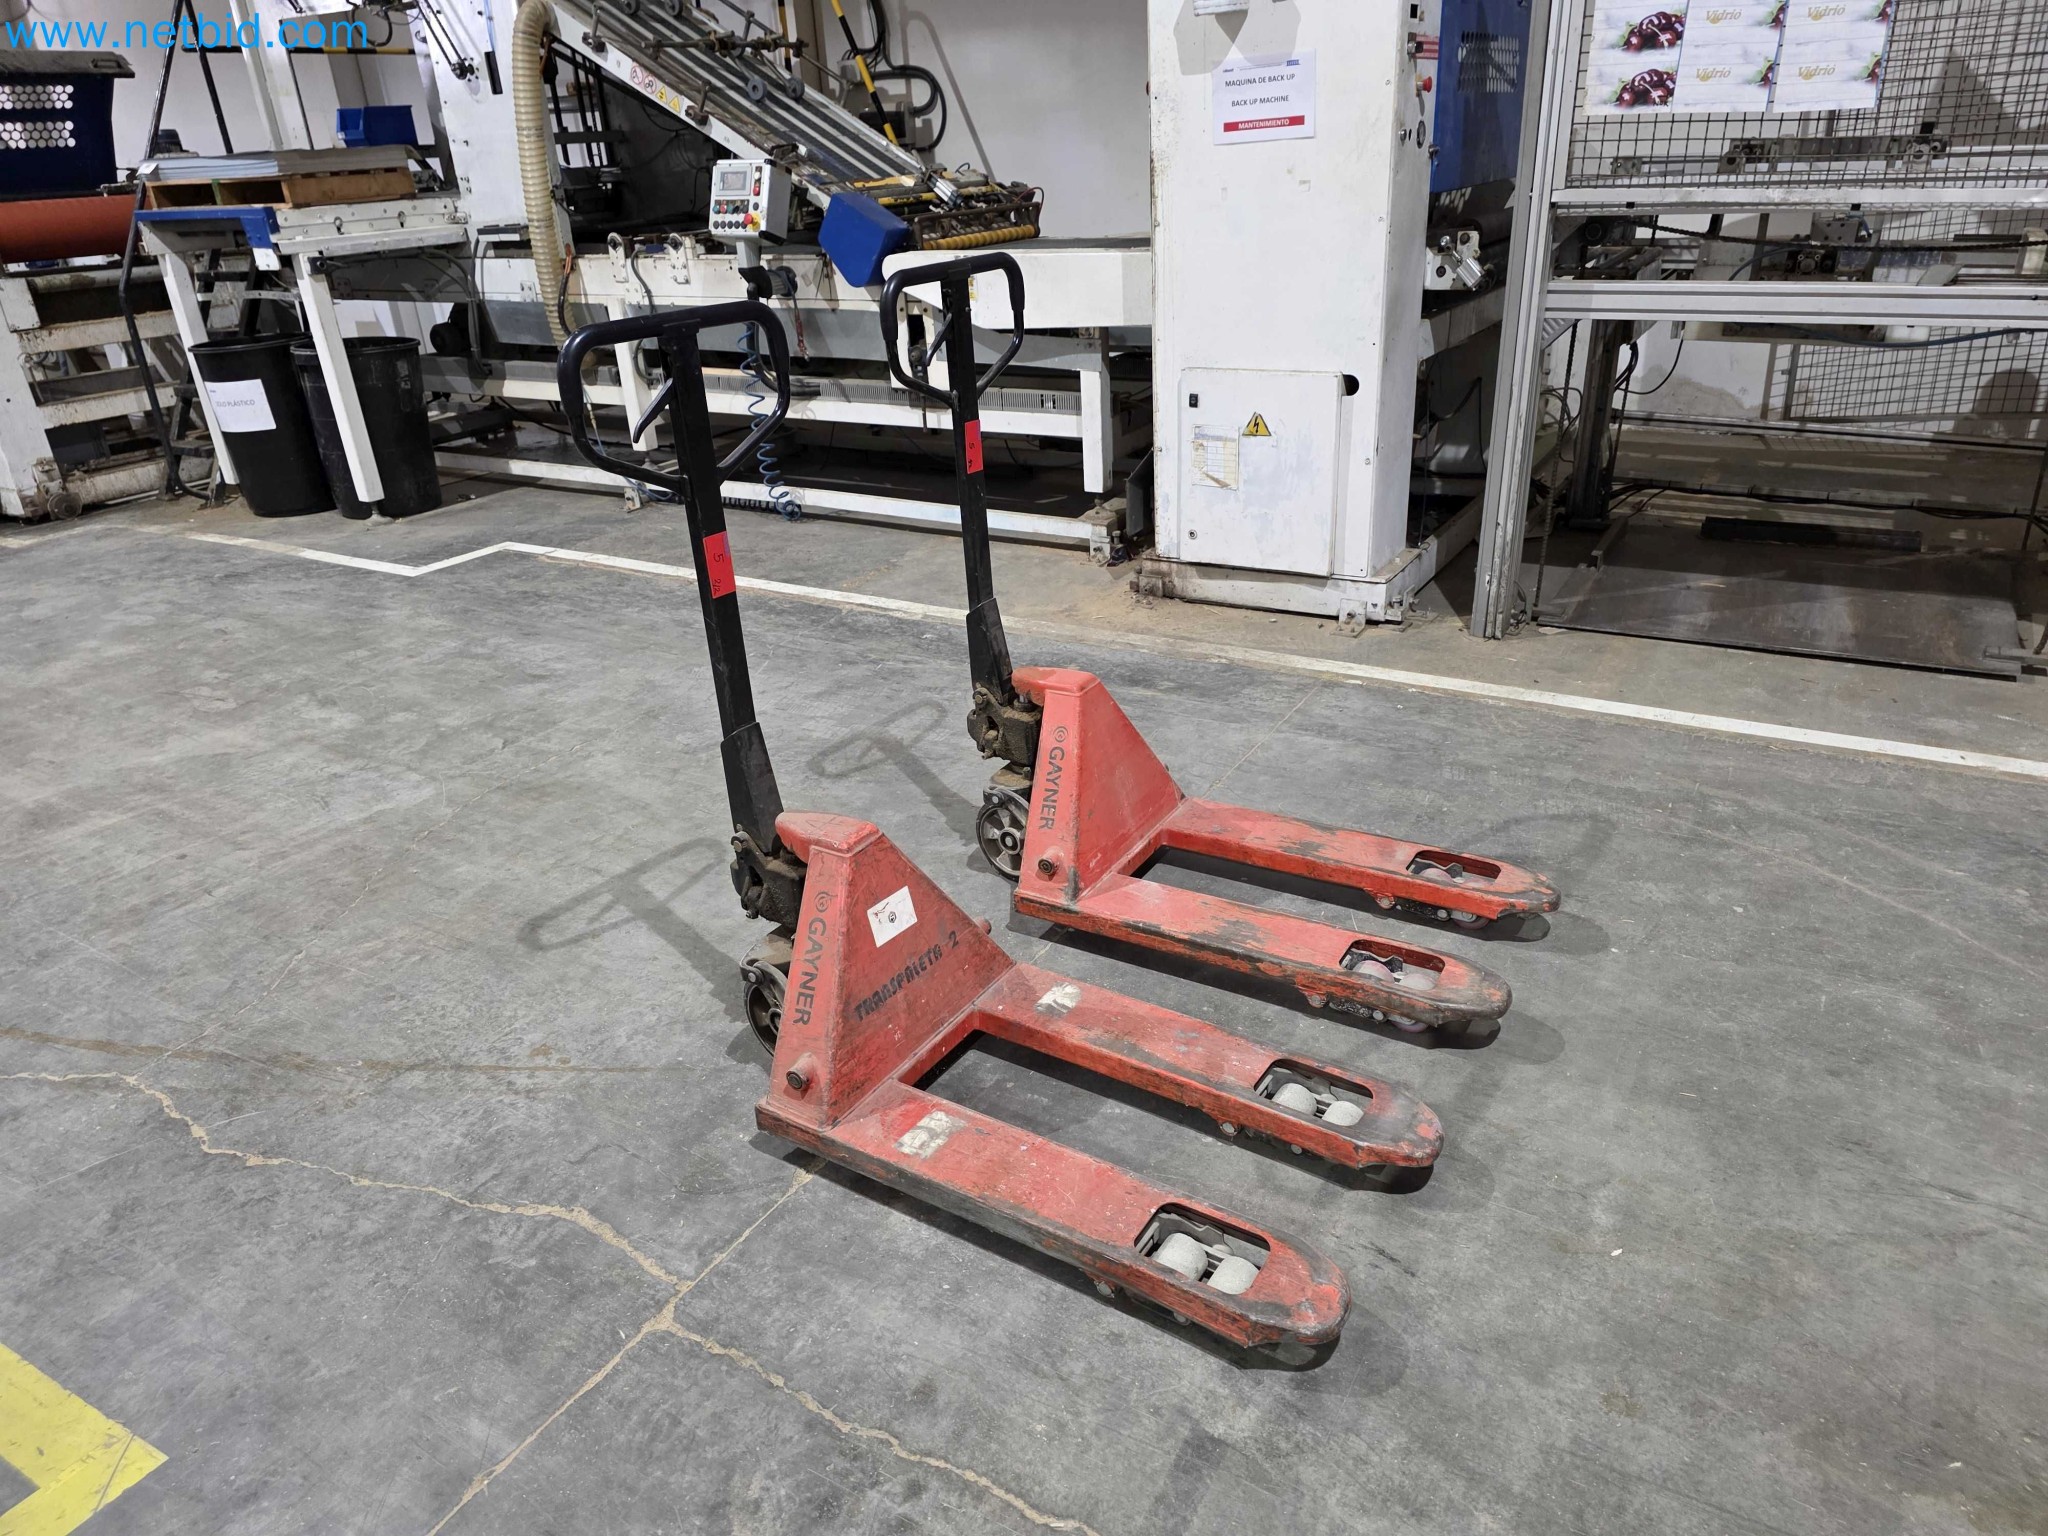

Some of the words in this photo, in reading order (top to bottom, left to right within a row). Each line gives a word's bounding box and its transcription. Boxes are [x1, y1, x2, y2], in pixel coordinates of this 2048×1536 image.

[1225, 77, 1257, 87] MAQUINA
[1258, 76, 1267, 84] DE
[1268, 74, 1284, 83] BACK
[1286, 73, 1296, 81] UP
[1231, 99, 1248, 107] BACK
[1249, 97, 1258, 105] UP
[1259, 95, 1289, 104] MACHINE
[1238, 119, 1290, 129] MANTENIMIENTO
[713, 552, 725, 564] 5
[1039, 746, 1065, 830] GAYNER
[793, 917, 827, 1026] GAYNER
